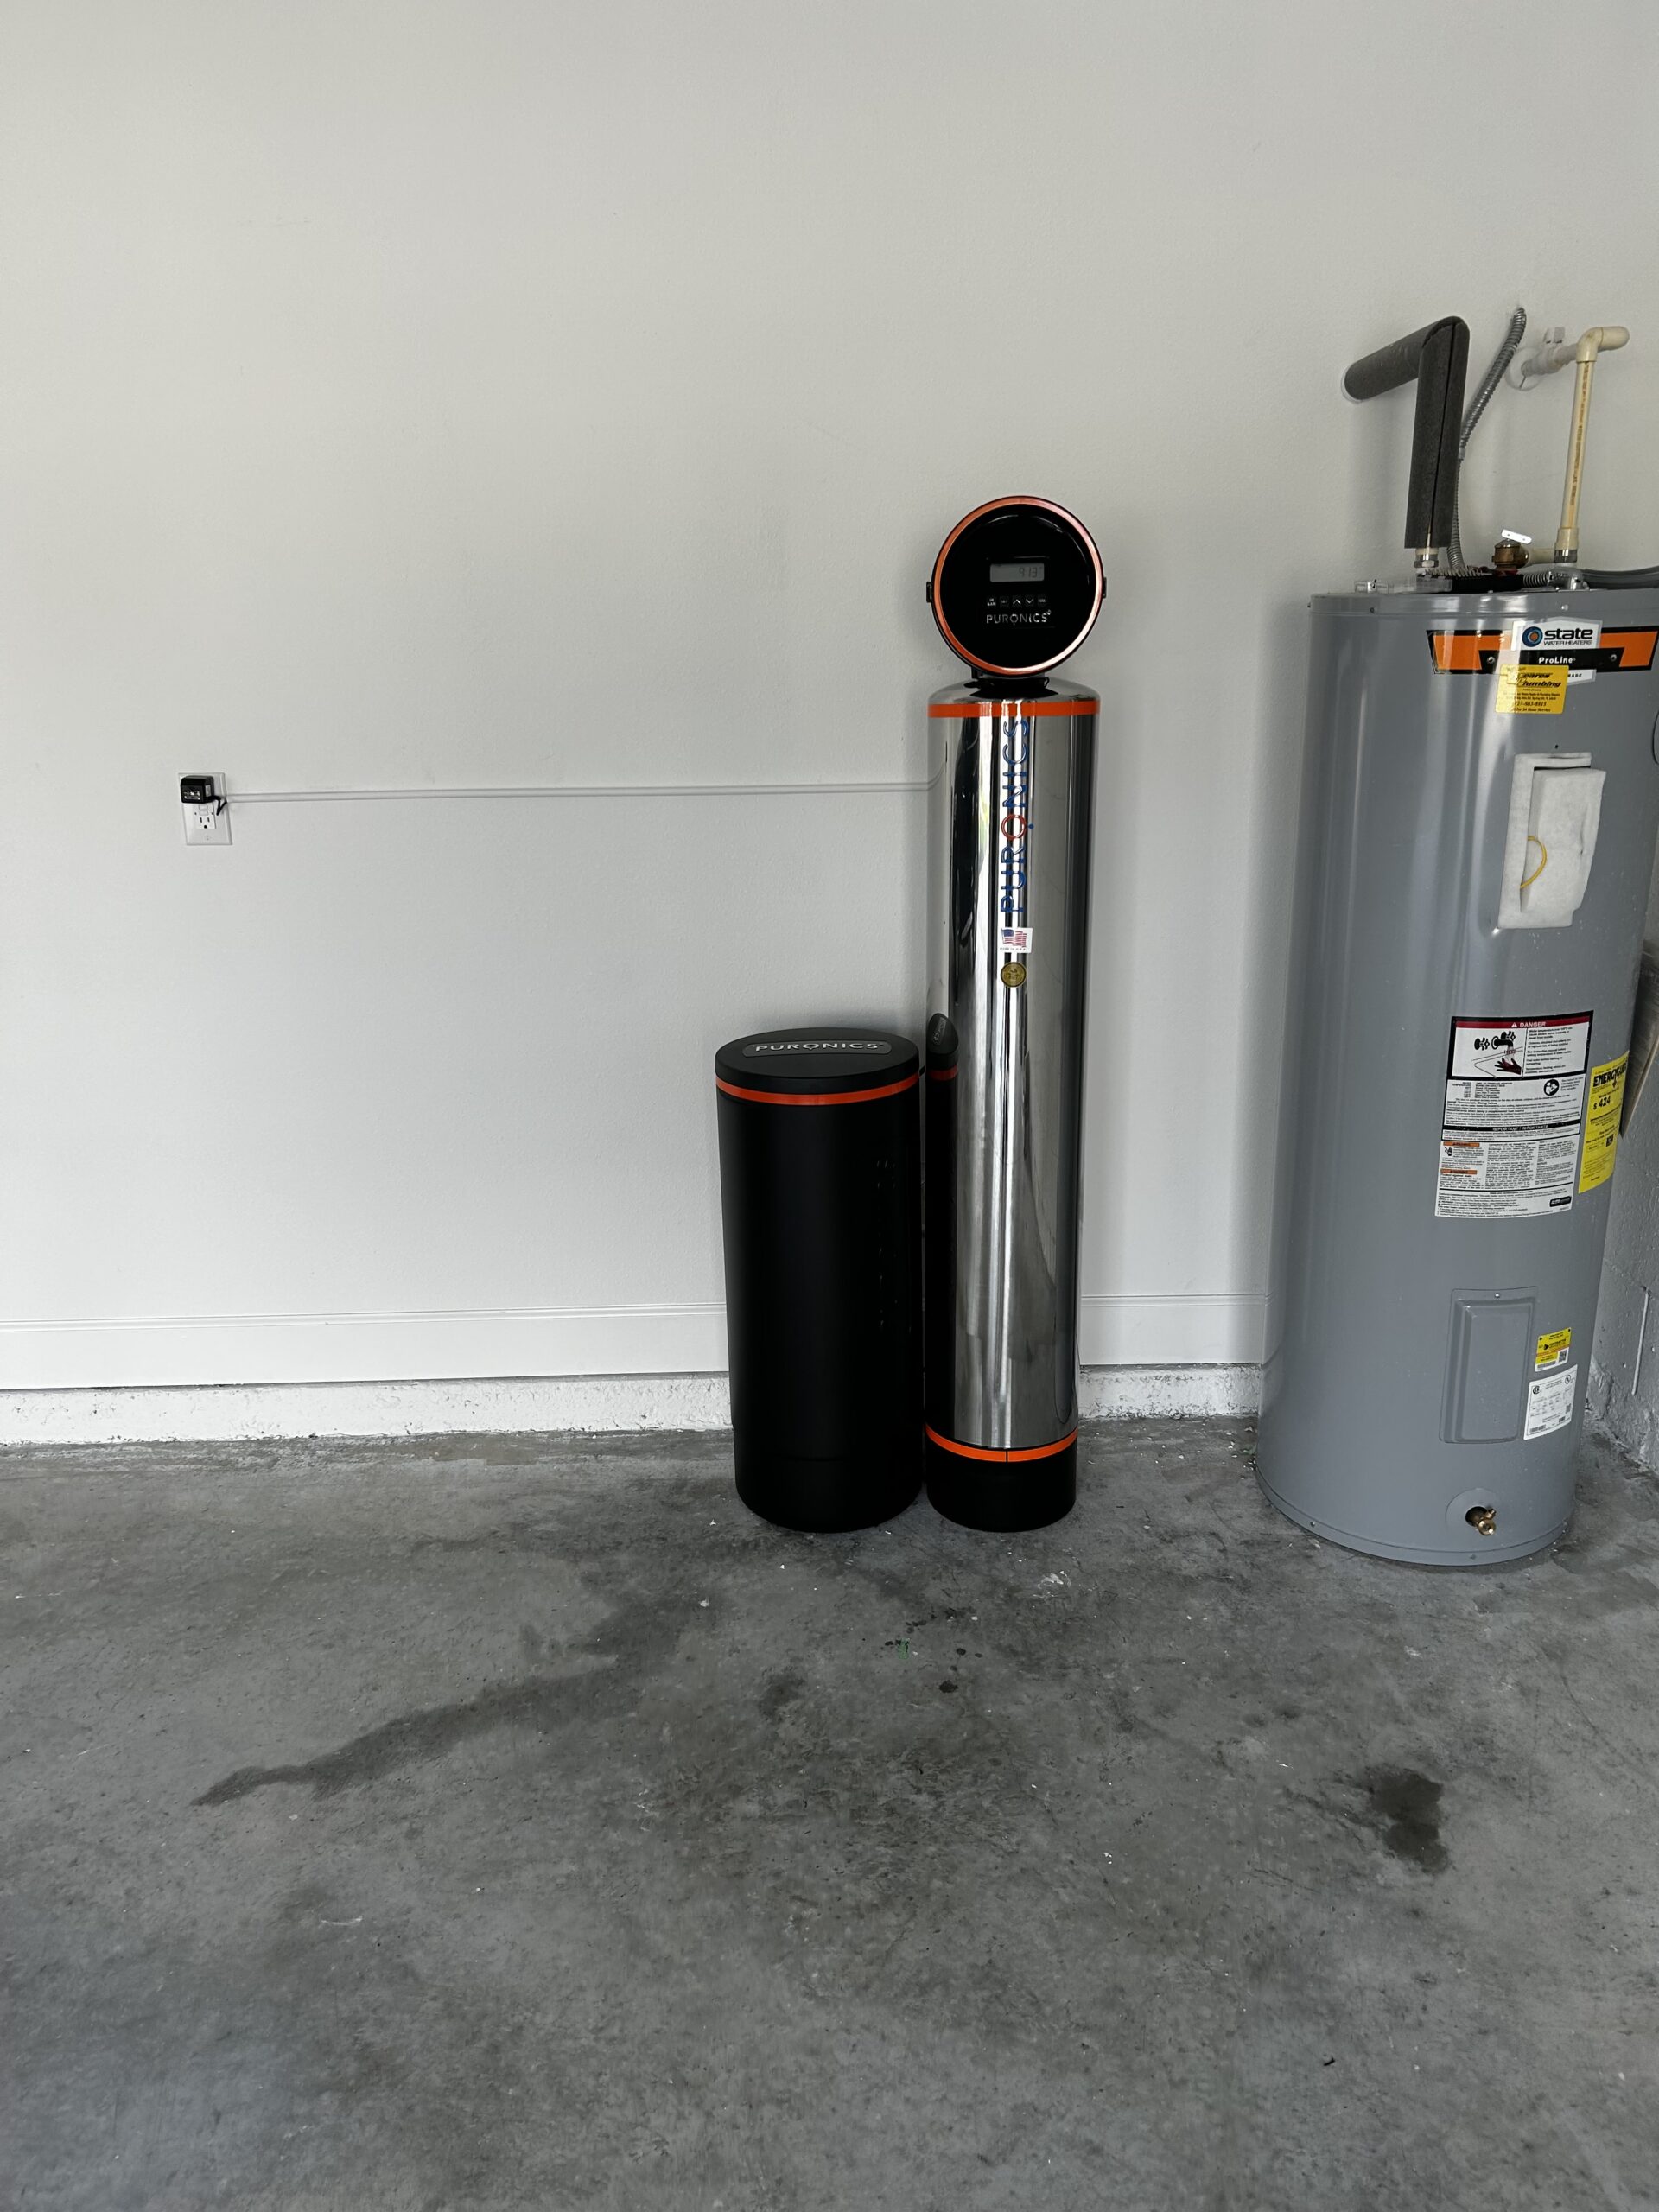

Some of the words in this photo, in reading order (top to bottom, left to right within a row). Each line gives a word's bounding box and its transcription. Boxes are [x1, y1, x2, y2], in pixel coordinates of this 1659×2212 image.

[986, 613, 1048, 625] PURONICS
[1544, 628, 1593, 639] state
[1538, 656, 1573, 664] ProLine
[1000, 720, 1029, 912] PURONICS
[755, 1042, 879, 1052] PURONICS
